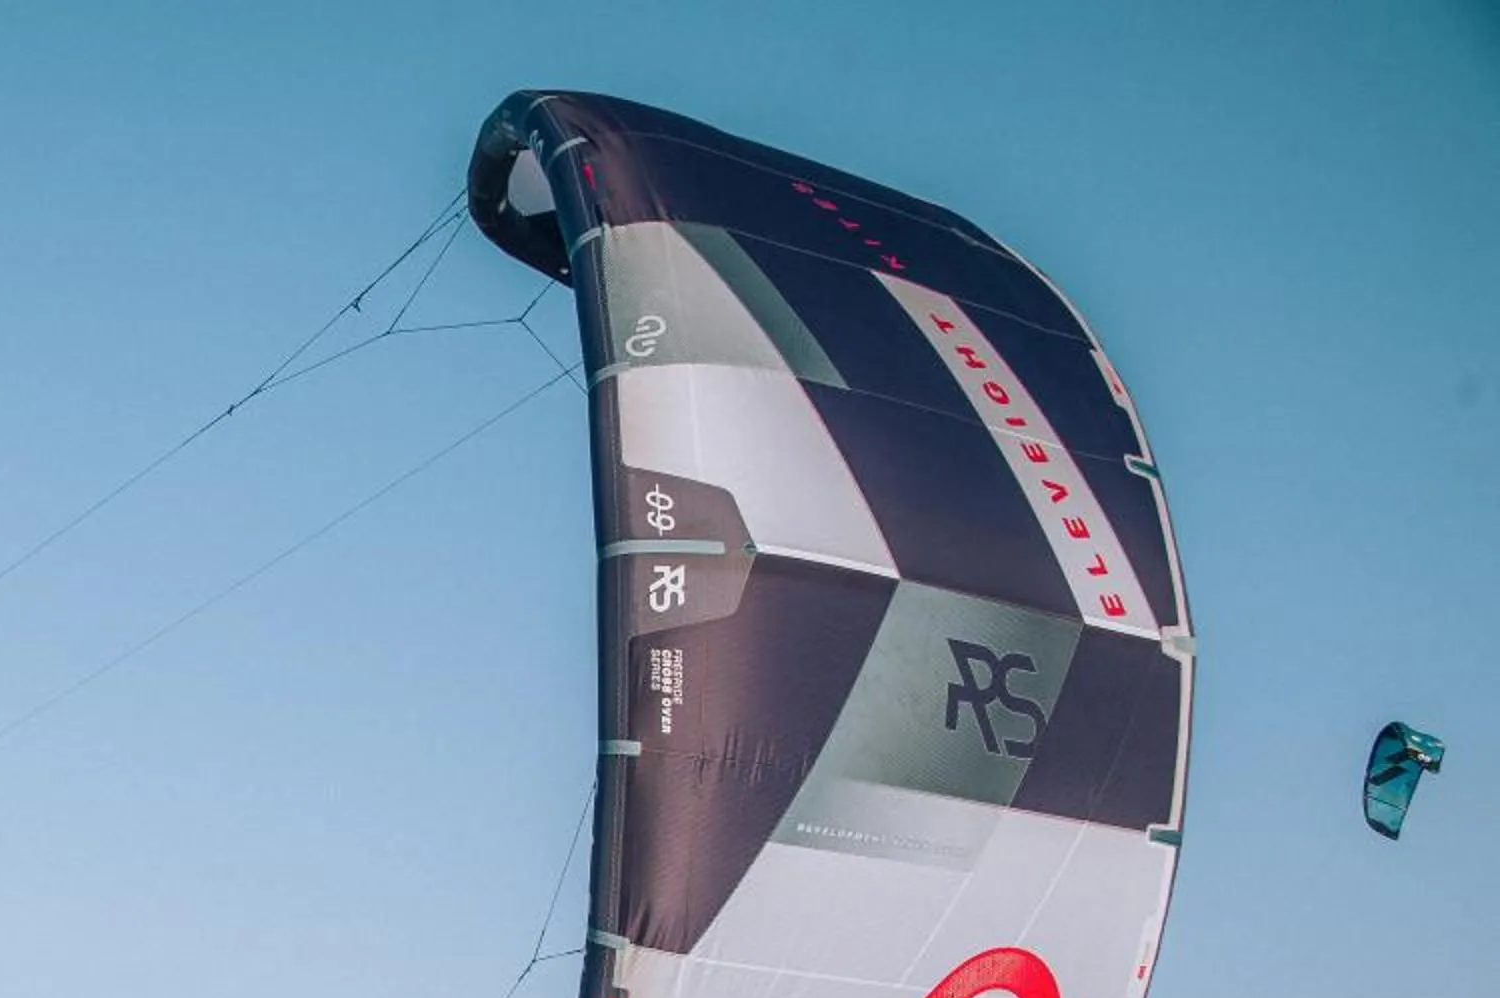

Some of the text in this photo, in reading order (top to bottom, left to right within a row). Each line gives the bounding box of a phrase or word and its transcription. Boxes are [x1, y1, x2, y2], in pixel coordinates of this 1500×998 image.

[929, 312, 1128, 618] ELEVEIGHT
[649, 564, 686, 612] RS
[650, 649, 661, 691] SERIES
[661, 649, 672, 734] CROSS OVER
[945, 637, 1050, 760] RS
